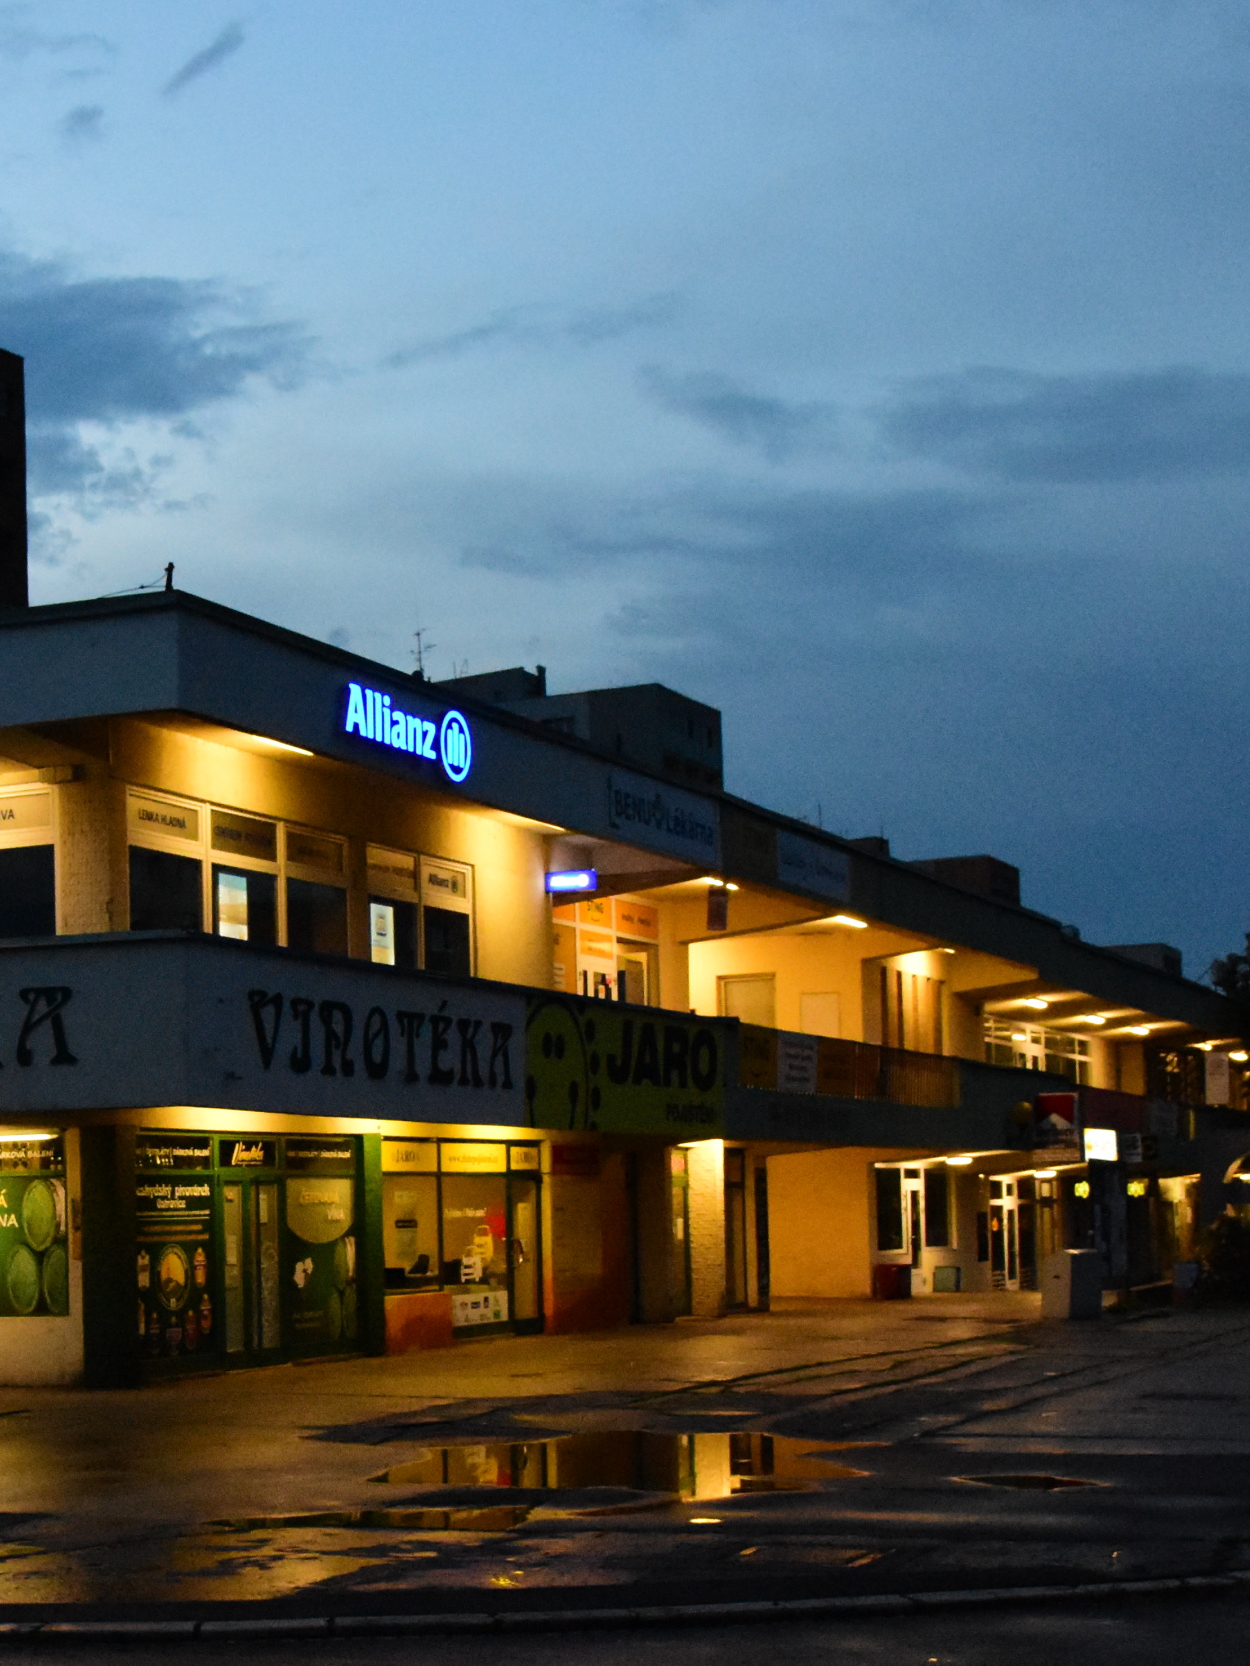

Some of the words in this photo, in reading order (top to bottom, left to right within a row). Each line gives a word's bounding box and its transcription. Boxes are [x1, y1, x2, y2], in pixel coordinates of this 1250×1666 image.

[345, 682, 437, 760] Allianz
[614, 790, 651, 827] BENU
[247, 989, 514, 1090] VINOTÉKA
[606, 1018, 718, 1093] JARO
